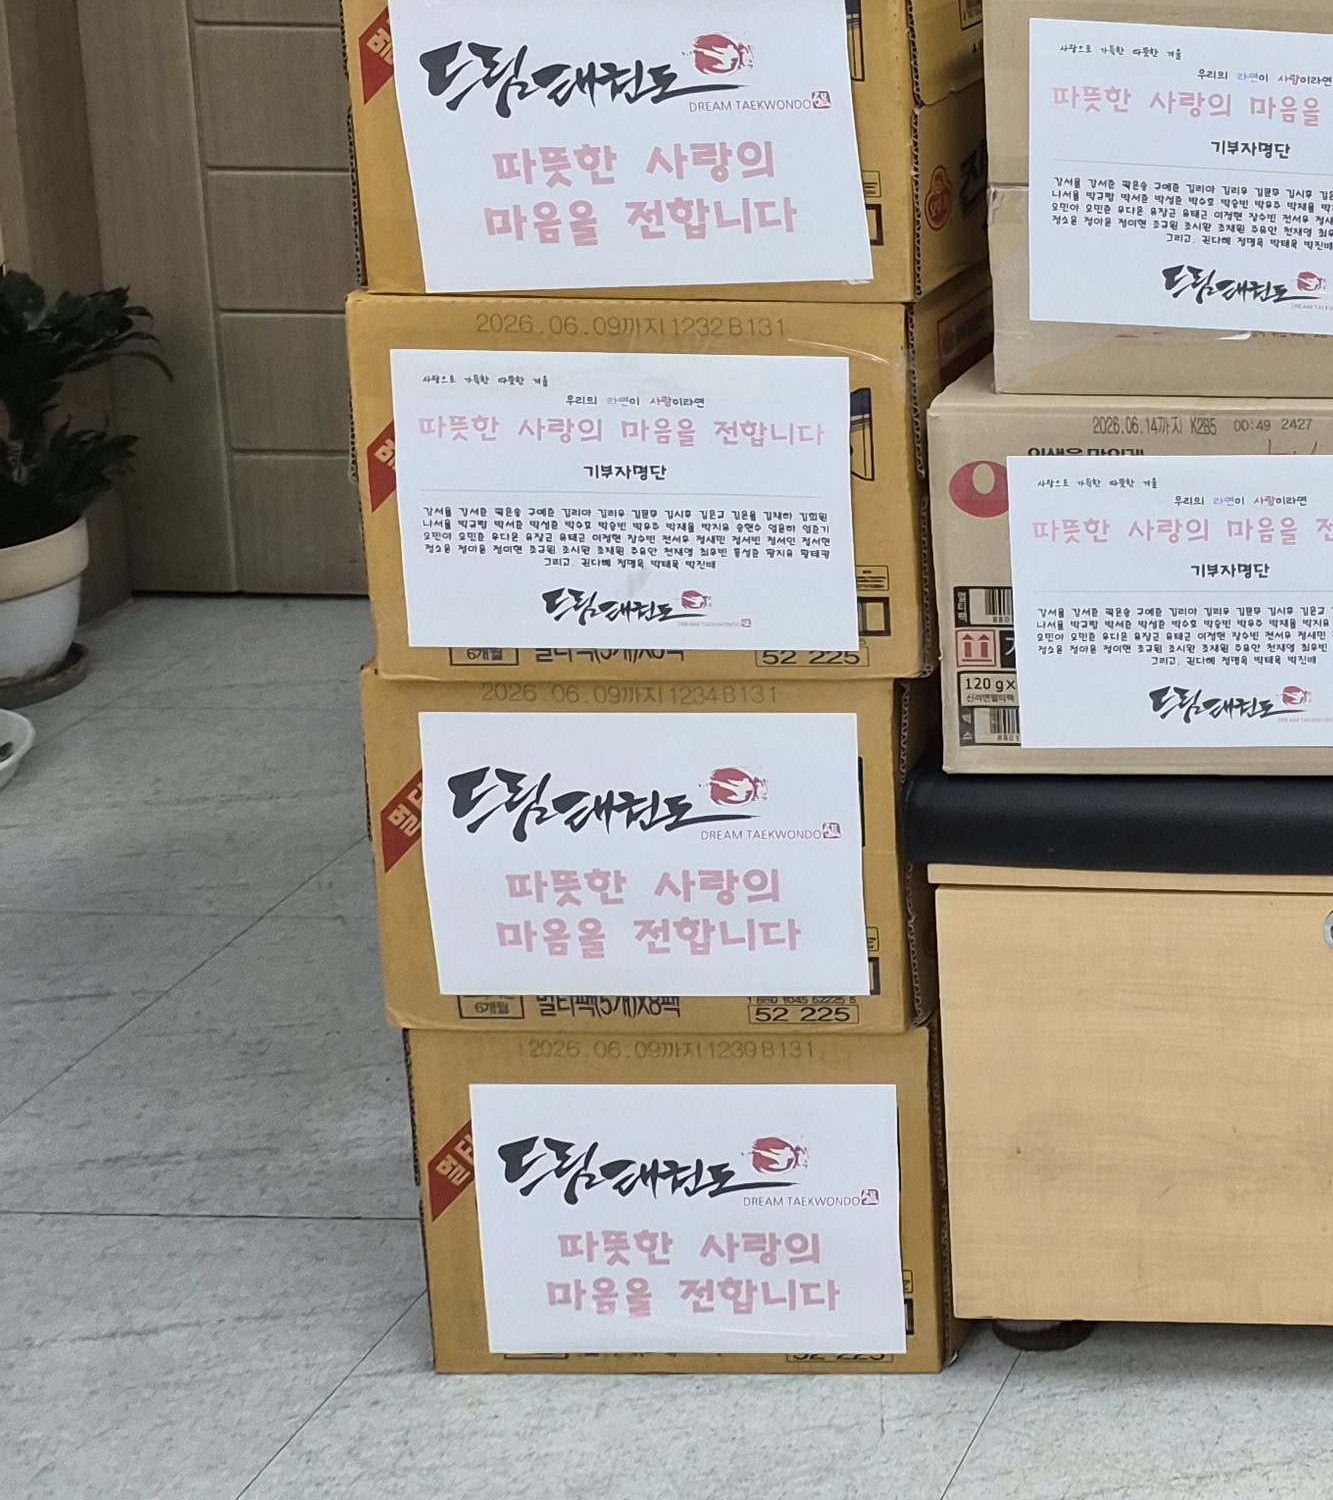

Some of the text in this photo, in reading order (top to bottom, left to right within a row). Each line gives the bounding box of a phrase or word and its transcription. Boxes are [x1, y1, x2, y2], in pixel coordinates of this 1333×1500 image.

[689, 99, 812, 113] DREAM TAEKWONDO
[1053, 86, 1131, 113] 따뜻한
[1149, 91, 1231, 118] 사랑의
[1250, 96, 1320, 127] 마음을
[1211, 140, 1290, 159] 기부자명단
[492, 141, 774, 188] 따뜻한 사랑의
[484, 197, 797, 246] 마음을 전합니다
[418, 415, 824, 447] 따뜻한 사랑의 마음을 전합니다
[1092, 416, 1182, 436] 2026.06.14까지
[1234, 418, 1271, 432] 00:49
[1281, 418, 1312, 430] 2427
[583, 465, 667, 481] 기부자명단
[1032, 518, 1110, 544] 따뜻한
[1128, 518, 1208, 544] 사랑의
[1227, 517, 1297, 545] 마음을
[1191, 563, 1270, 579] 기부자명단
[965, 678, 991, 690] 120
[701, 829, 822, 840] DREAM TAEKWONDO
[505, 868, 780, 907] 따뜻한 사랑의
[496, 916, 801, 959] 마음을 전합니다
[755, 1008, 851, 1022] 52 225
[743, 1196, 860, 1207] DREAM TAEKWONDO
[558, 1229, 820, 1267] 따뜻한 사랑의
[546, 1277, 840, 1318] 마음을 전합니다
